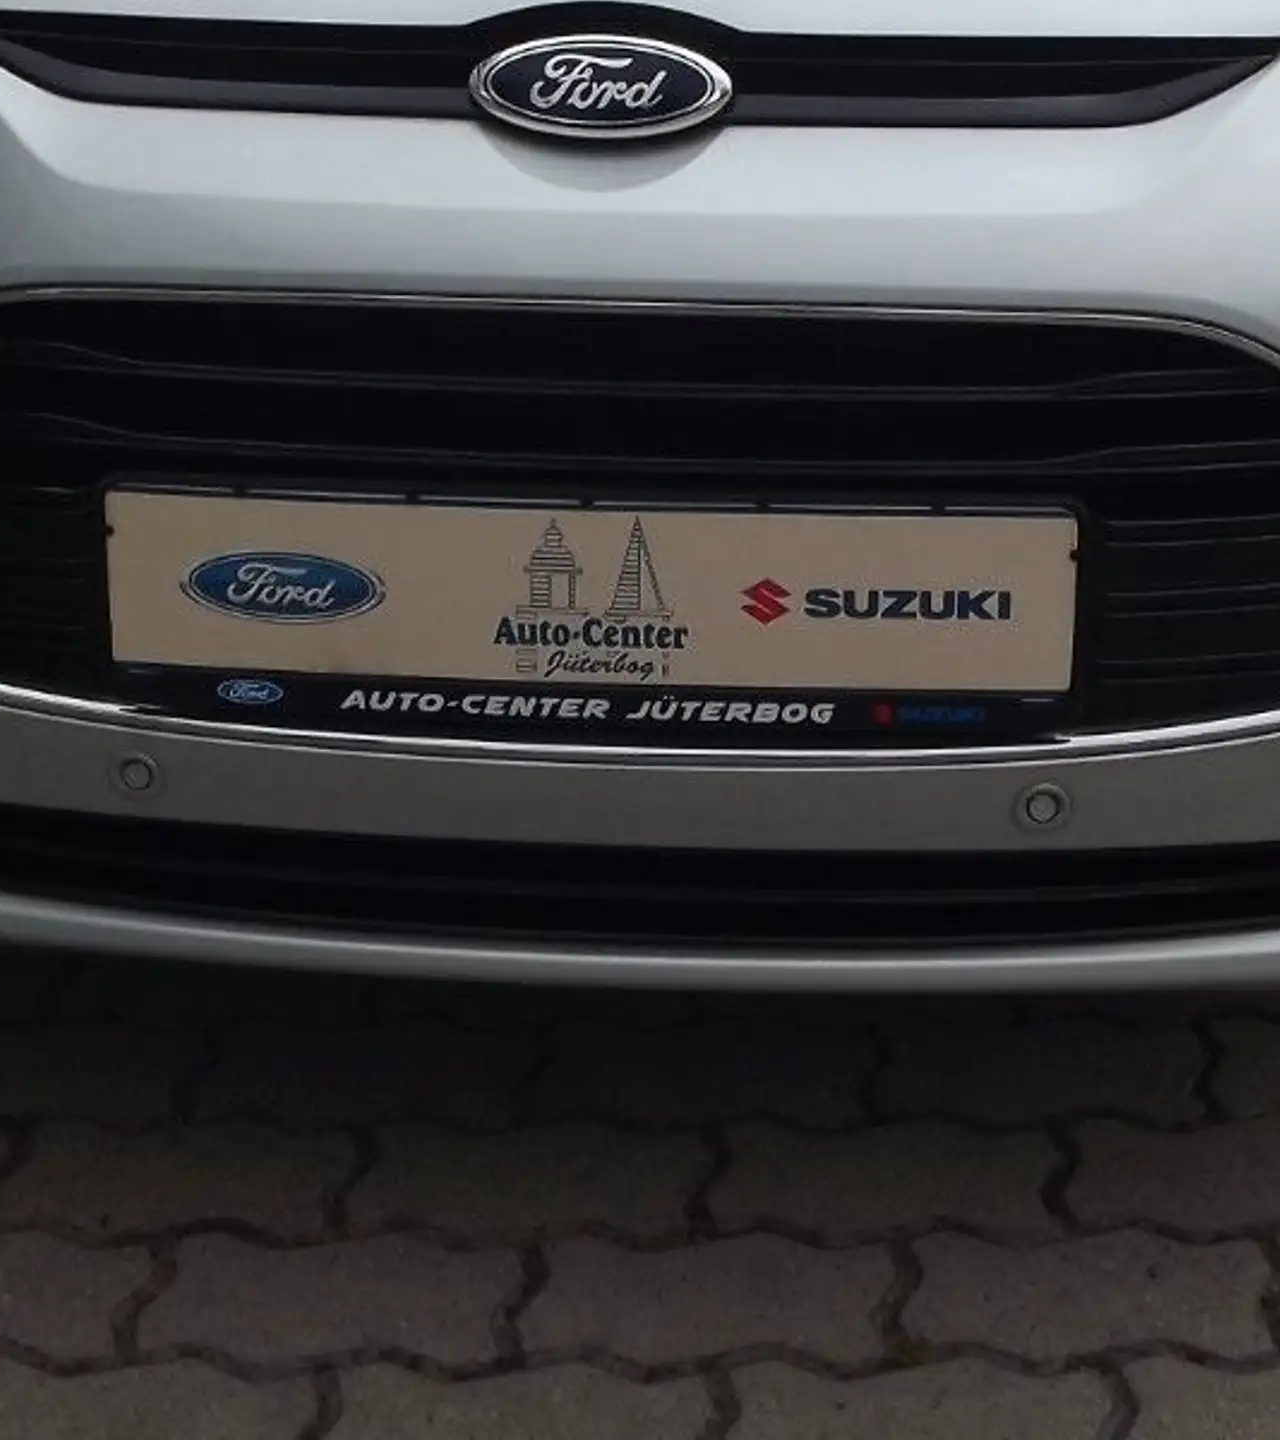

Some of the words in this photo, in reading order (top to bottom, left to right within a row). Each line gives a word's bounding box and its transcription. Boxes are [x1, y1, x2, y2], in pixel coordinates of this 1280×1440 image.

[529, 54, 667, 109] Ford
[227, 563, 336, 608] Ford
[804, 588, 1012, 620] SUZUKI
[494, 616, 688, 649] Auto-Center
[544, 649, 656, 681] Jüterbog
[340, 689, 611, 720] AUTO-CENTER
[627, 696, 835, 724] JÜTERBOG
